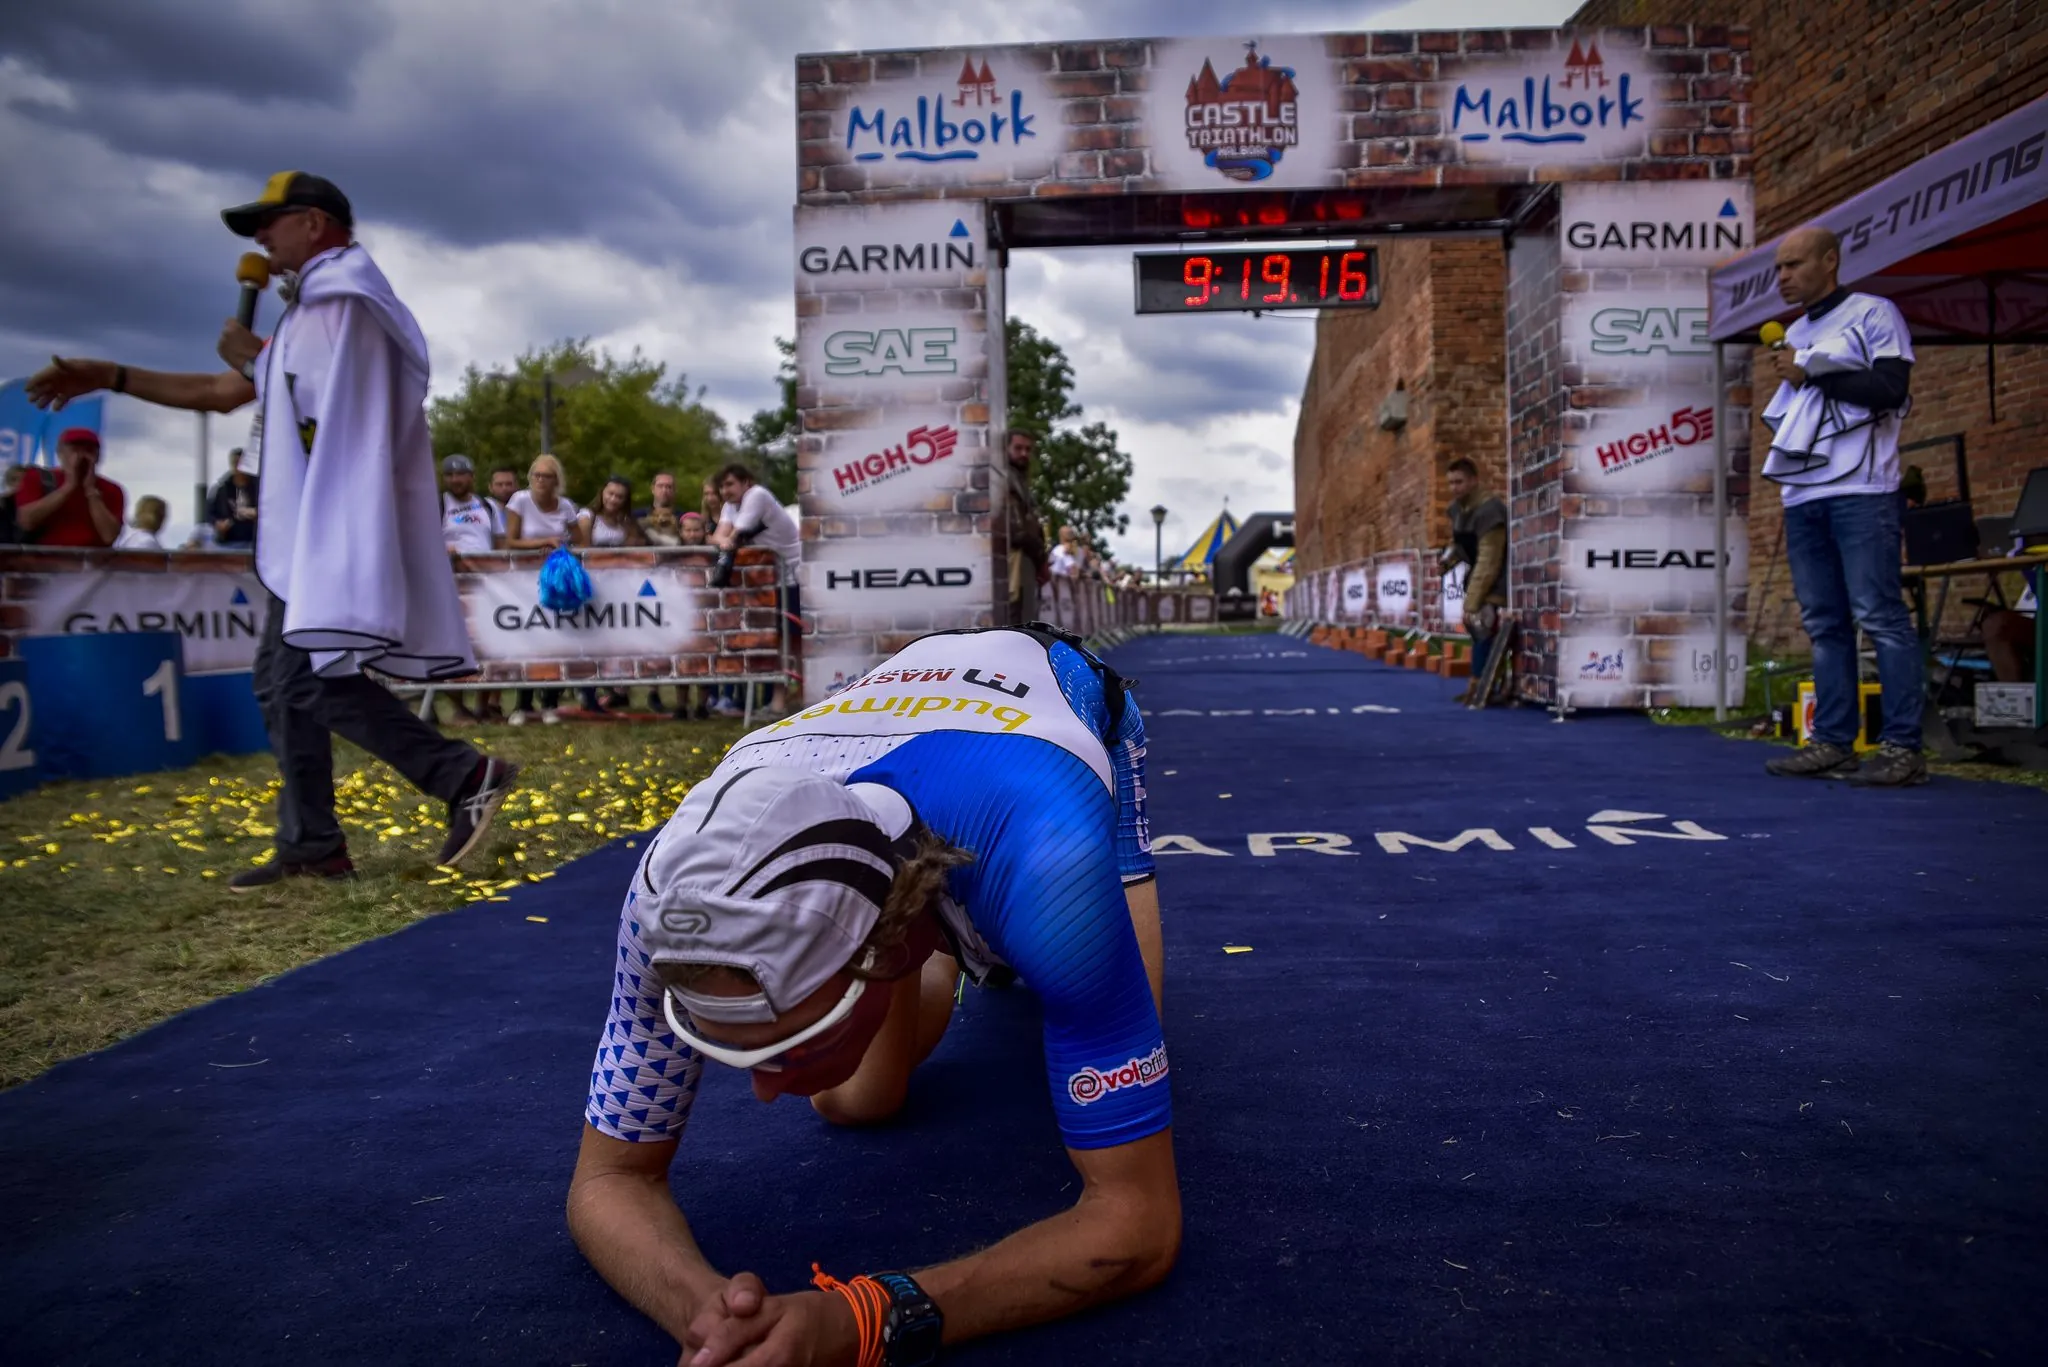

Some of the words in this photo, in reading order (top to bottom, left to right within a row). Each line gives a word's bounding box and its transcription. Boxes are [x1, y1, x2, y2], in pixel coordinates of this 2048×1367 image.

[846, 89, 1036, 150] Malbork
[1188, 101, 1295, 126] CASTLE
[1453, 72, 1644, 130] Malbork
[1188, 126, 1296, 146] TRIATHLON
[1567, 220, 1743, 251] GARMIN
[801, 241, 974, 274] GARMIN
[824, 327, 957, 376] SAE
[826, 567, 972, 590] HEAD
[142, 659, 182, 742] 1
[0, 681, 36, 770] 2
[1152, 816, 1729, 858] ARMIN
